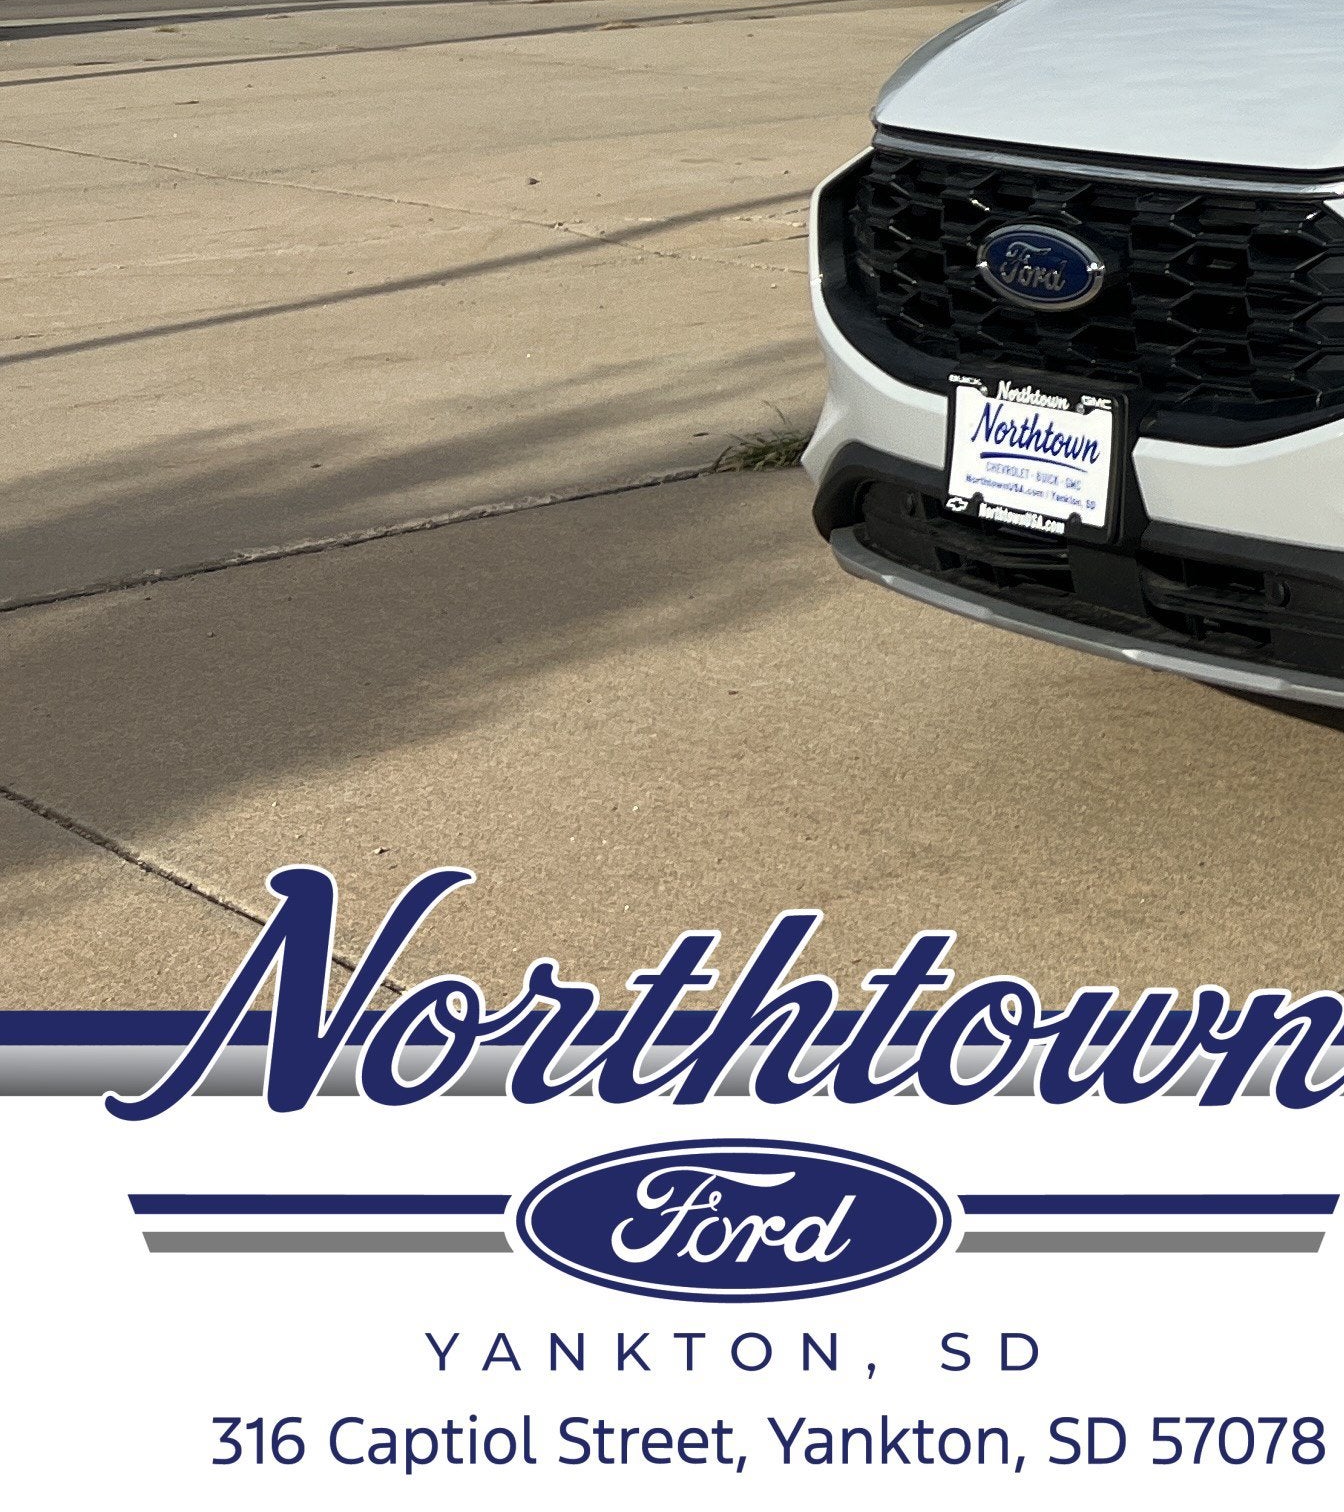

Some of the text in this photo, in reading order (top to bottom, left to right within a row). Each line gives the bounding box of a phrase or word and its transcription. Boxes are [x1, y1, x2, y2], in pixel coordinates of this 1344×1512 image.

[1001, 241, 1067, 291] Ford
[997, 380, 1070, 411] Northtown
[1081, 395, 1112, 410] GMC
[968, 402, 1101, 464] Northtown
[986, 461, 1030, 479] CHEVROLET
[1036, 471, 1059, 486] BUICK
[978, 502, 1065, 535] NorthtownUSA.com
